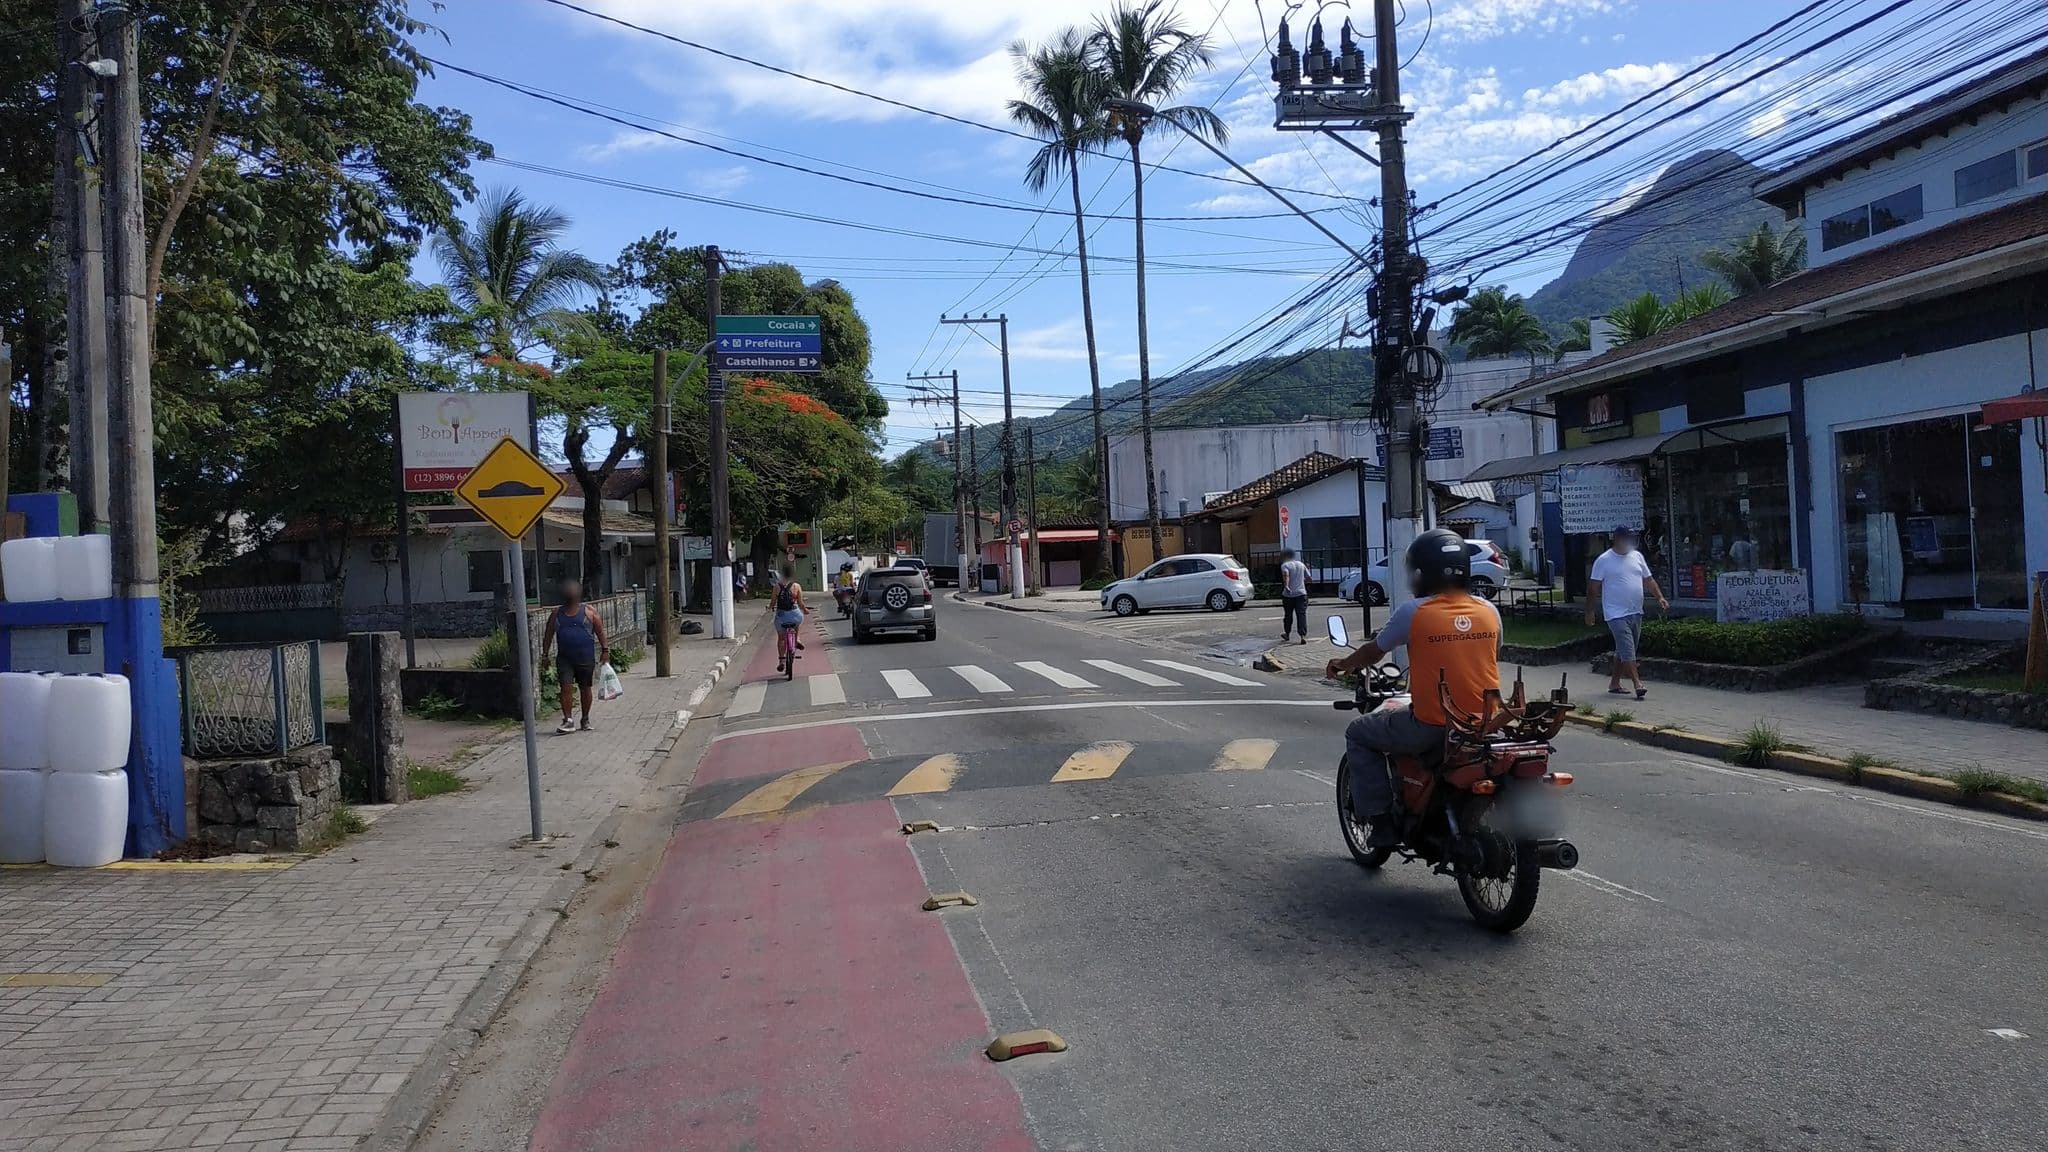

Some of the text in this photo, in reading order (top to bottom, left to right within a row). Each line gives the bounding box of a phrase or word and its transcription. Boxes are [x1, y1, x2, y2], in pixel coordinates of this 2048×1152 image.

[768, 320, 805, 329] Cocaia
[745, 339, 802, 348] Prefeitura
[726, 357, 796, 366] Castelhanos
[418, 424, 452, 440] Bon
[414, 473, 432, 483] (12)
[434, 473, 455, 482] 3896
[1726, 575, 1800, 587] FLORICULTURA
[1428, 631, 1497, 643] SUPERGASBRAS
